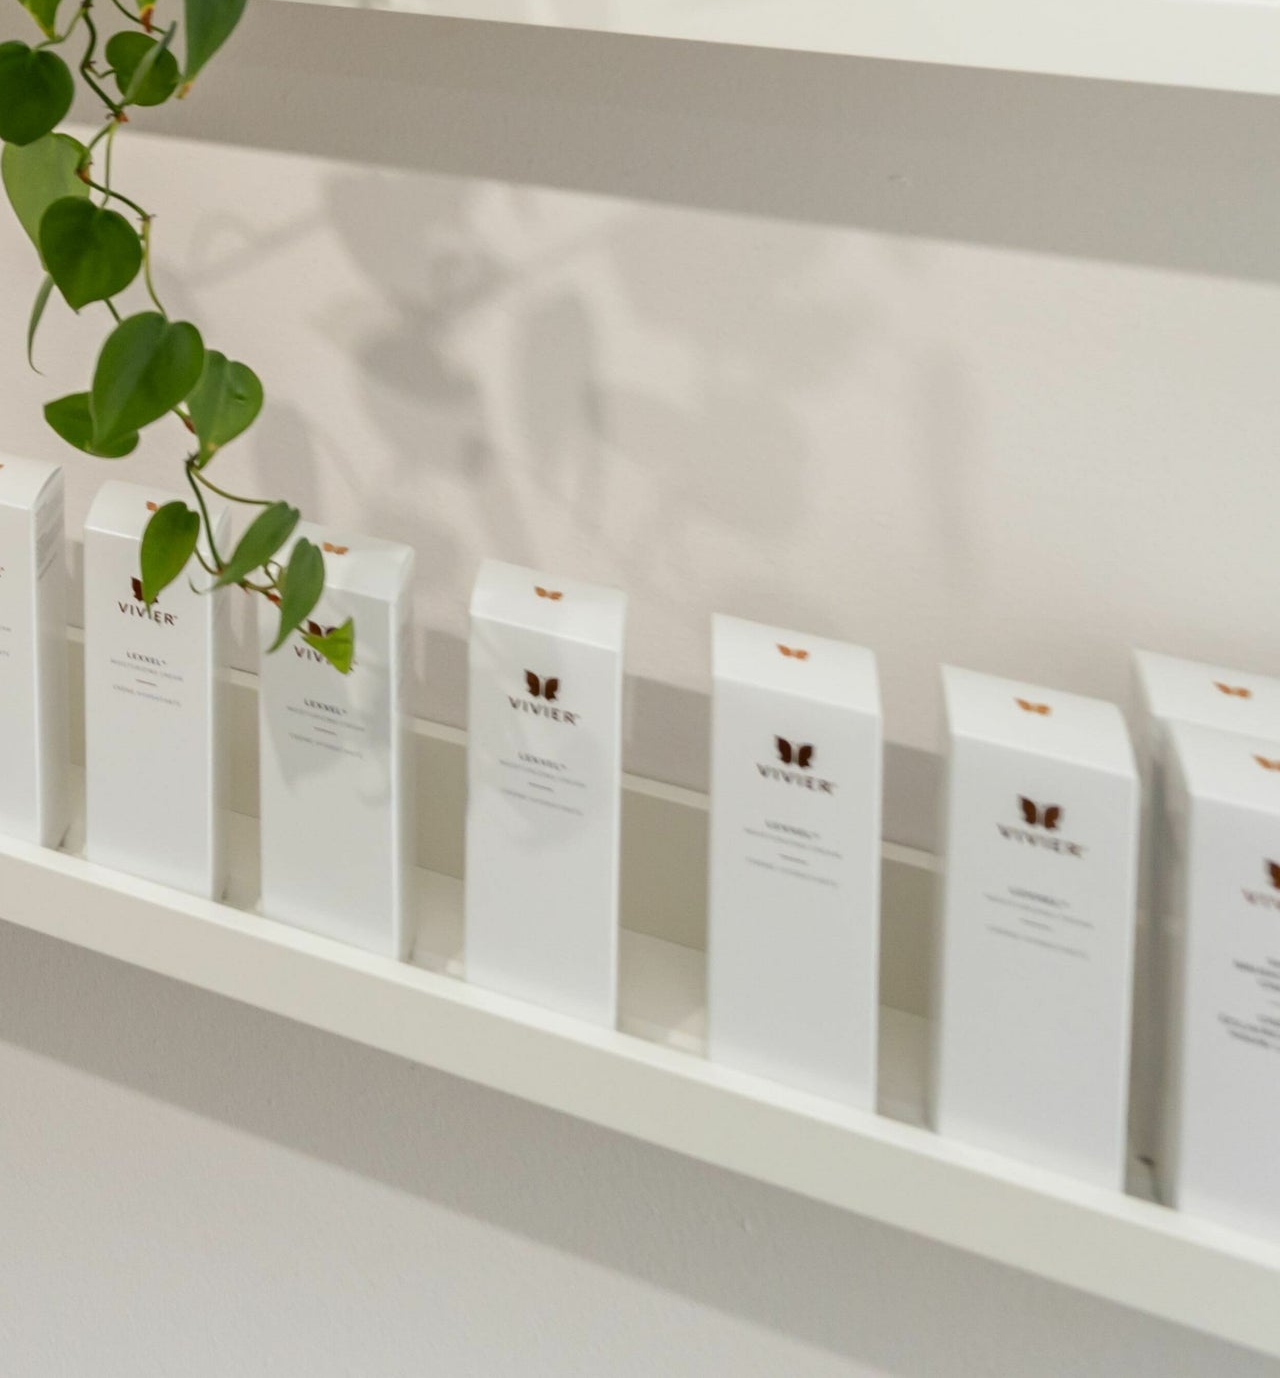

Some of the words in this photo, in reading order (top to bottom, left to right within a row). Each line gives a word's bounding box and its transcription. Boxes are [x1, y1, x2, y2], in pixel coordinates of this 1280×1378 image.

[118, 602, 175, 626] VIVER
[508, 697, 576, 724] VIVIER
[757, 764, 834, 794] VIVIER
[998, 826, 1084, 857] VIVIER
